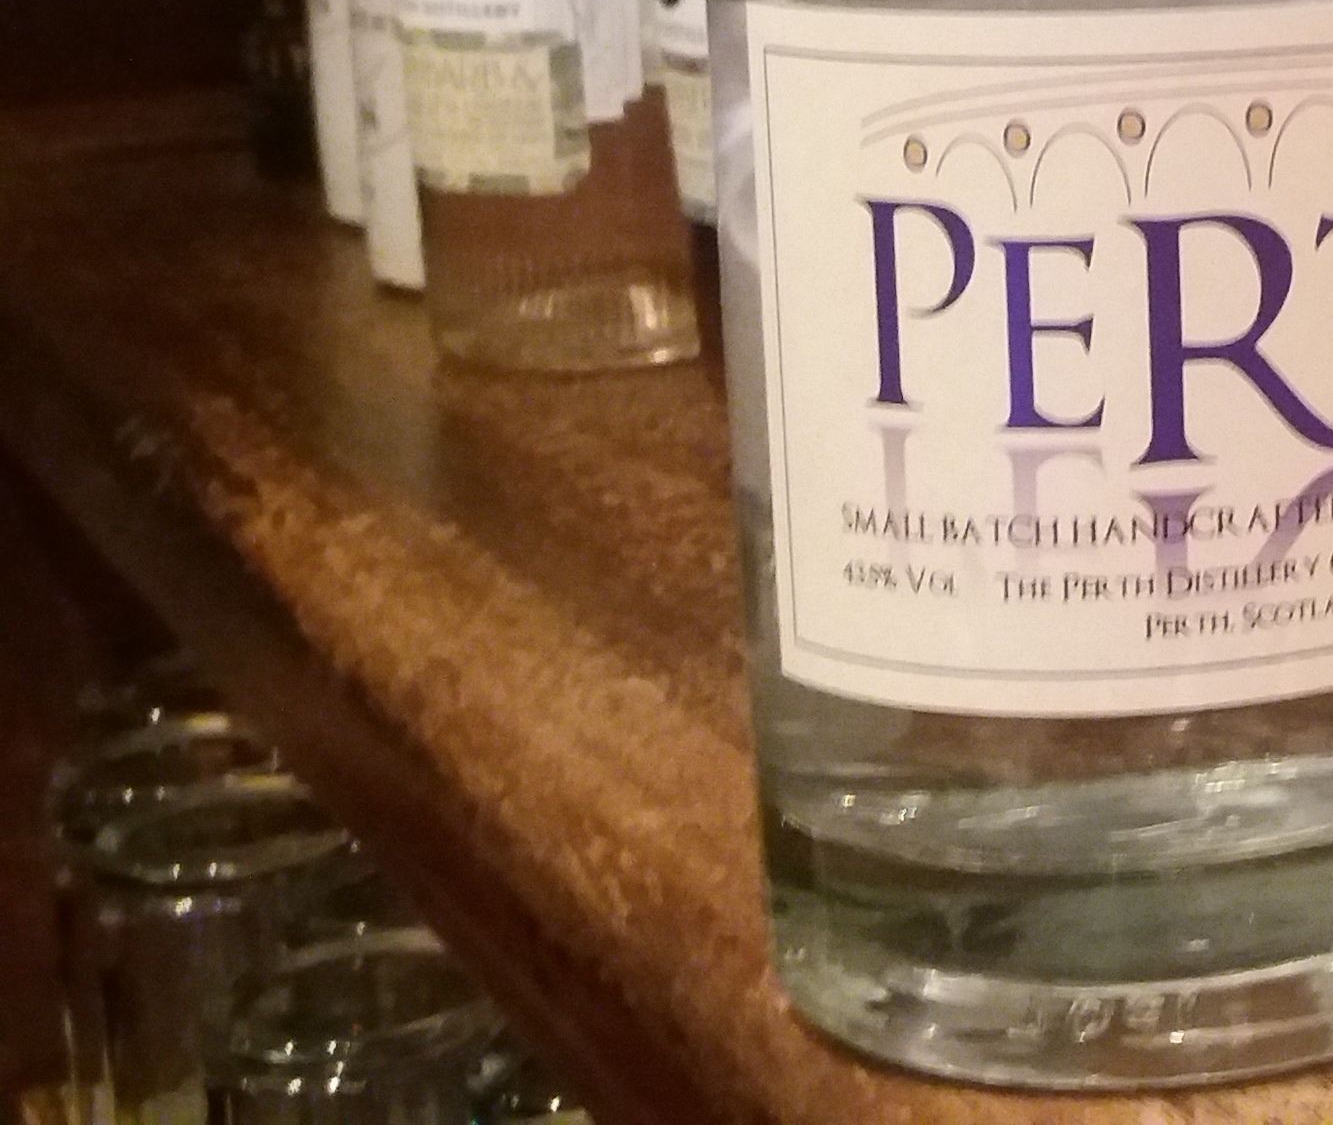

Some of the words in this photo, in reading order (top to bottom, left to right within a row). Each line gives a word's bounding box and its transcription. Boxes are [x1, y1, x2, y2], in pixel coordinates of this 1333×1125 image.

[841, 501, 933, 544] SMALL
[942, 512, 1060, 548] BATCH
[994, 570, 1053, 603] THE
[1063, 570, 1155, 603] PERTH
[1166, 552, 1321, 600] DISTILLERY
